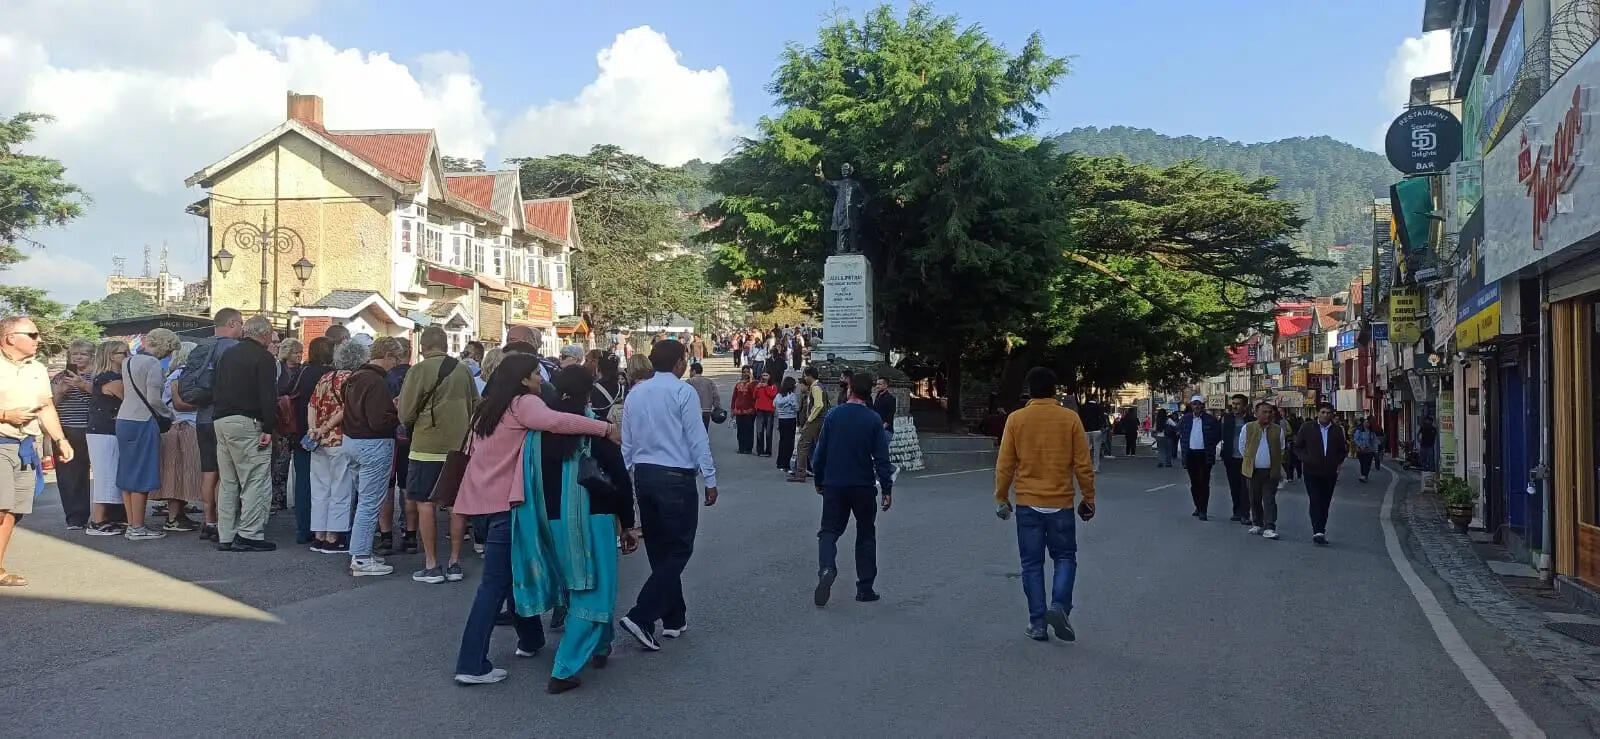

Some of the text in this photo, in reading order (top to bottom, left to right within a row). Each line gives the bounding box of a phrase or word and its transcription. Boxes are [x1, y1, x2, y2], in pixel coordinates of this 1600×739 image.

[1398, 109, 1449, 127] RESTAURANT
[1415, 162, 1434, 170] BAR
[160, 320, 180, 328] SINCE
